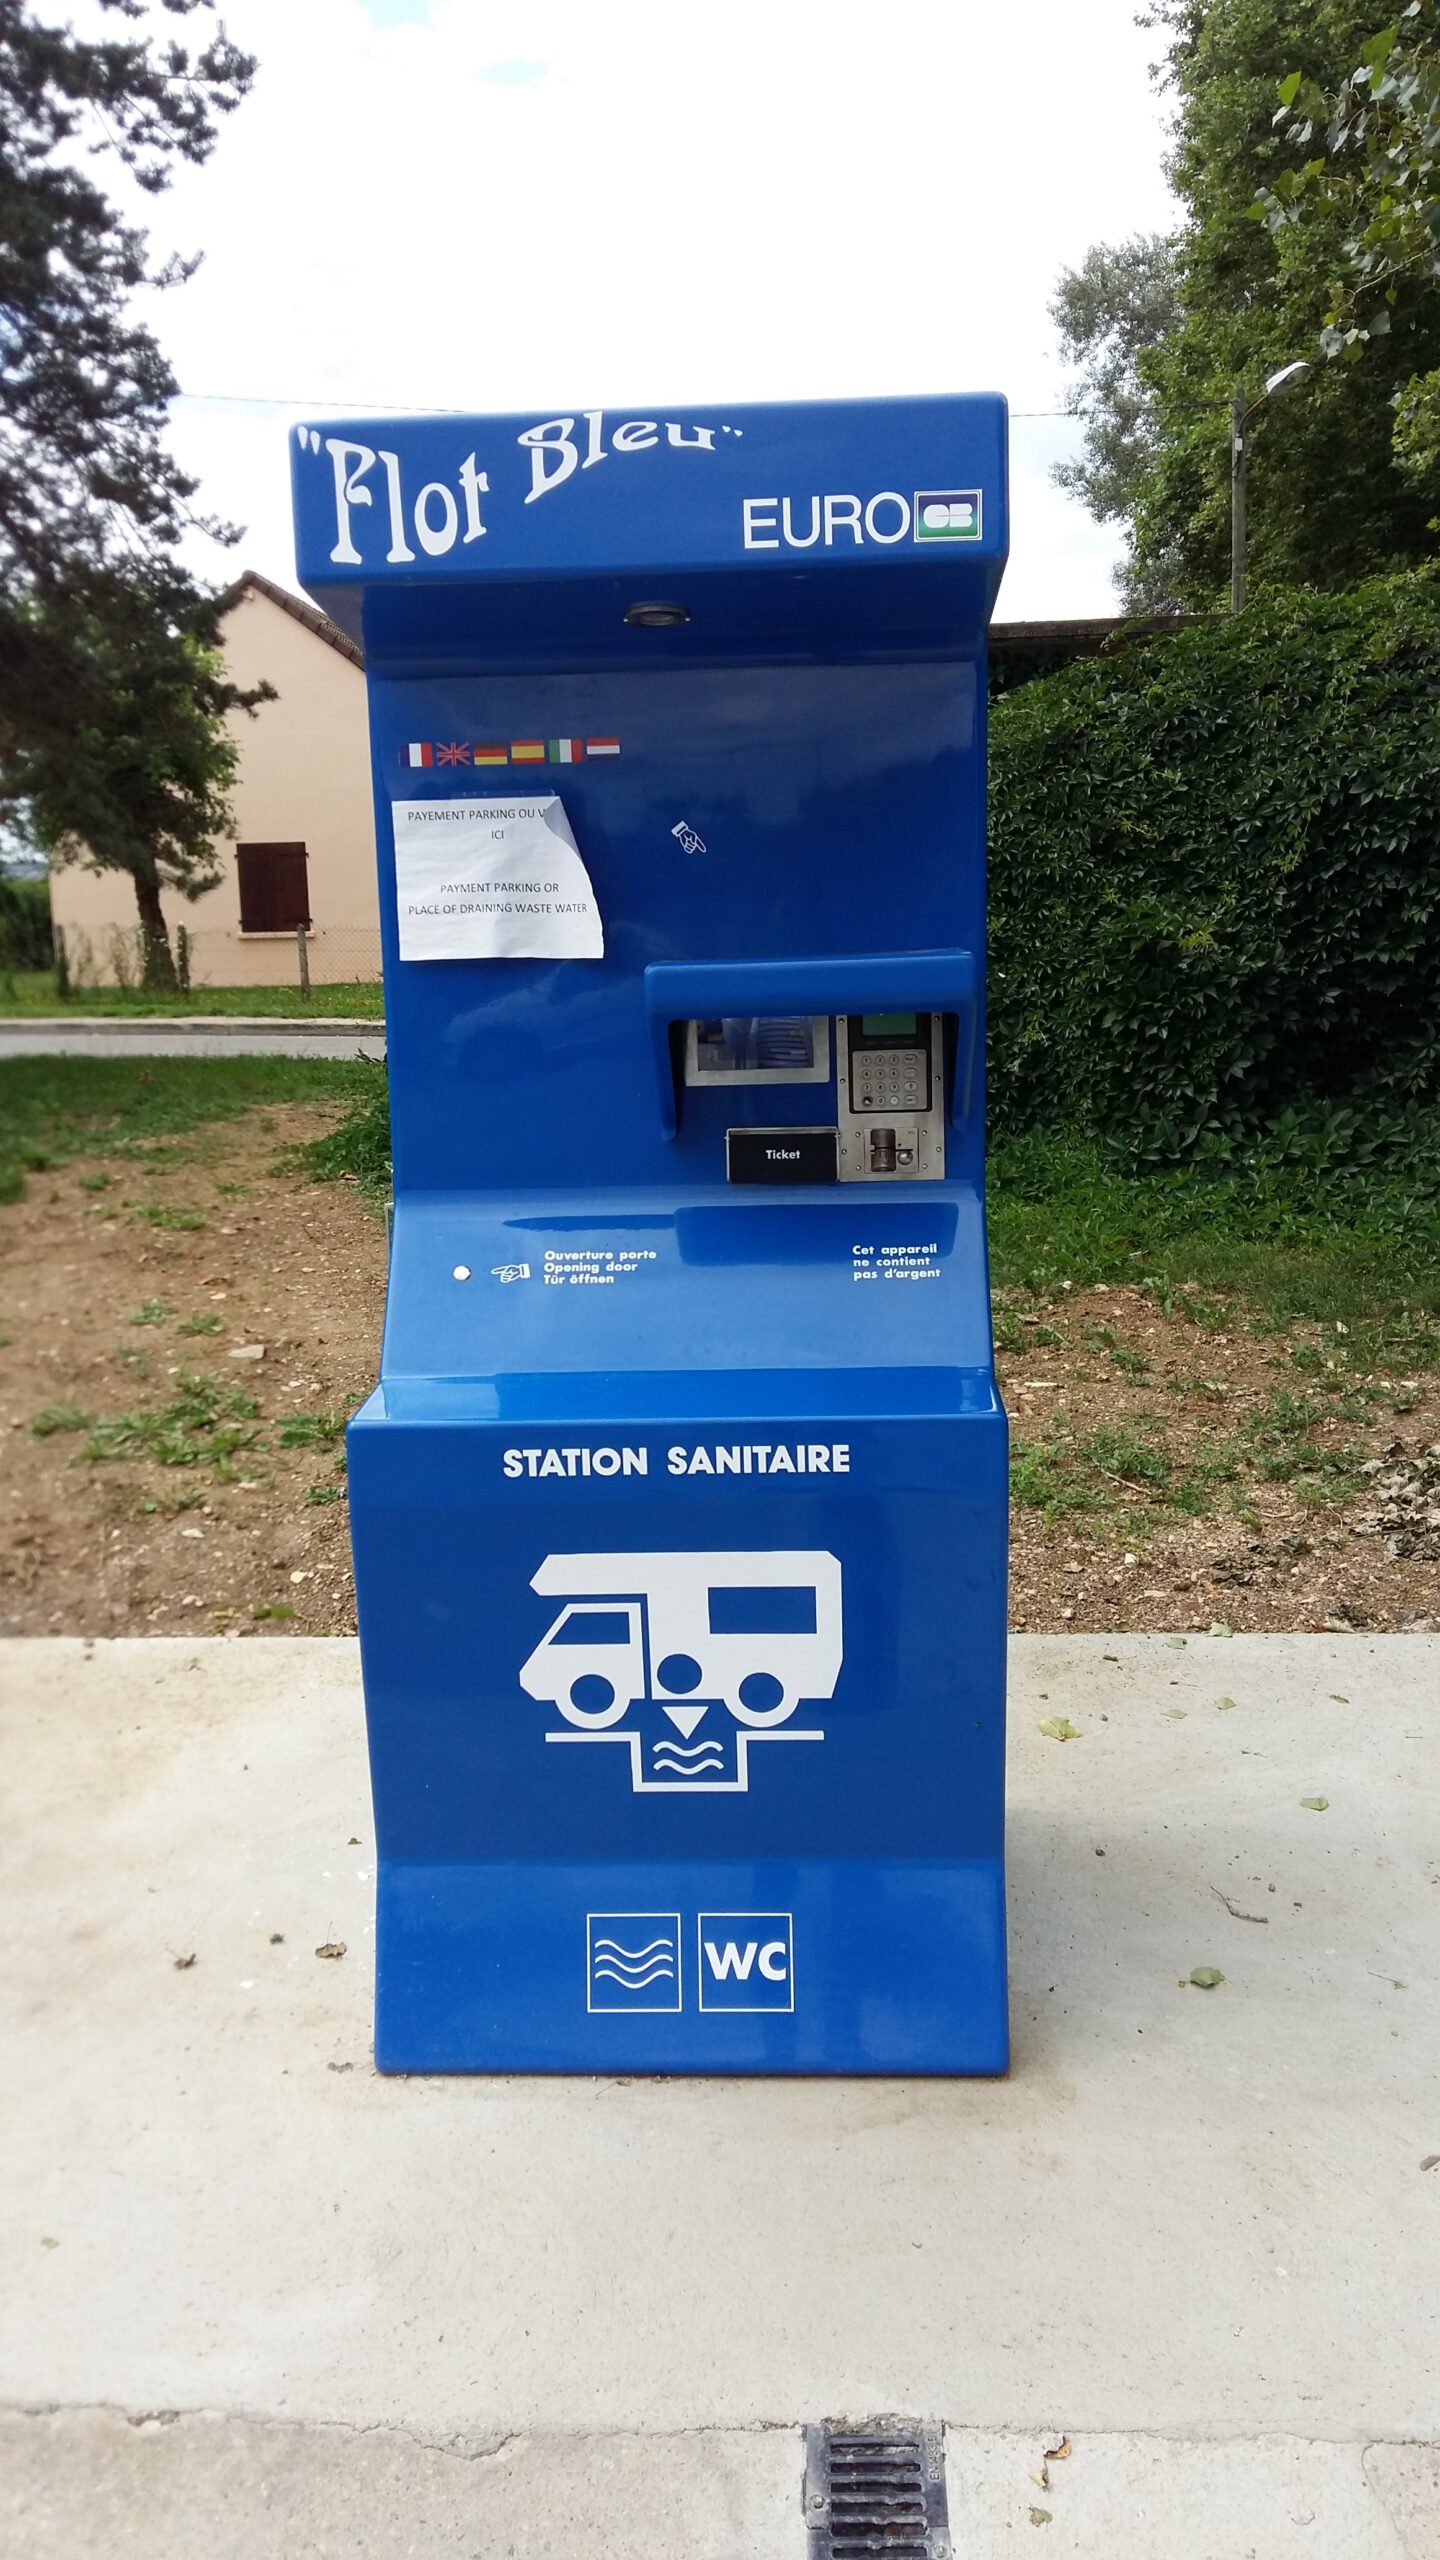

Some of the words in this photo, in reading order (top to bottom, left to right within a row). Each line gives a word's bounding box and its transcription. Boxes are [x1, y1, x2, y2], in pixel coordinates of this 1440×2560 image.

[743, 492, 911, 549] EURO
[924, 503, 973, 529] CB
[407, 810, 466, 821] PAYEMENT
[469, 808, 516, 820] PARKING
[518, 808, 535, 819] OU
[491, 829, 504, 840] ICI
[440, 882, 492, 893] PAYMENT
[494, 882, 541, 893] PARKING
[543, 882, 559, 893] OR
[408, 904, 440, 915] PLACE
[442, 904, 457, 915] OF
[459, 902, 513, 914] DRAINING
[514, 903, 552, 914] WASTE
[554, 903, 587, 914] WATER
[765, 1149, 801, 1160] Ticket
[545, 1251, 613, 1260] Ouverture
[620, 1251, 656, 1261] porte
[852, 1245, 875, 1255] Cet
[880, 1243, 938, 1257] appareil
[544, 1262, 600, 1274] Opening
[606, 1261, 638, 1271] door
[877, 1256, 930, 1266] contient
[544, 1274, 565, 1284] Tür
[569, 1273, 613, 1283] öffnen
[853, 1271, 878, 1282] pas
[884, 1268, 941, 1281] d'argent
[504, 1448, 647, 1477] STATION
[668, 1445, 849, 1474] SANITAIRE
[705, 1942, 786, 1980] WC
